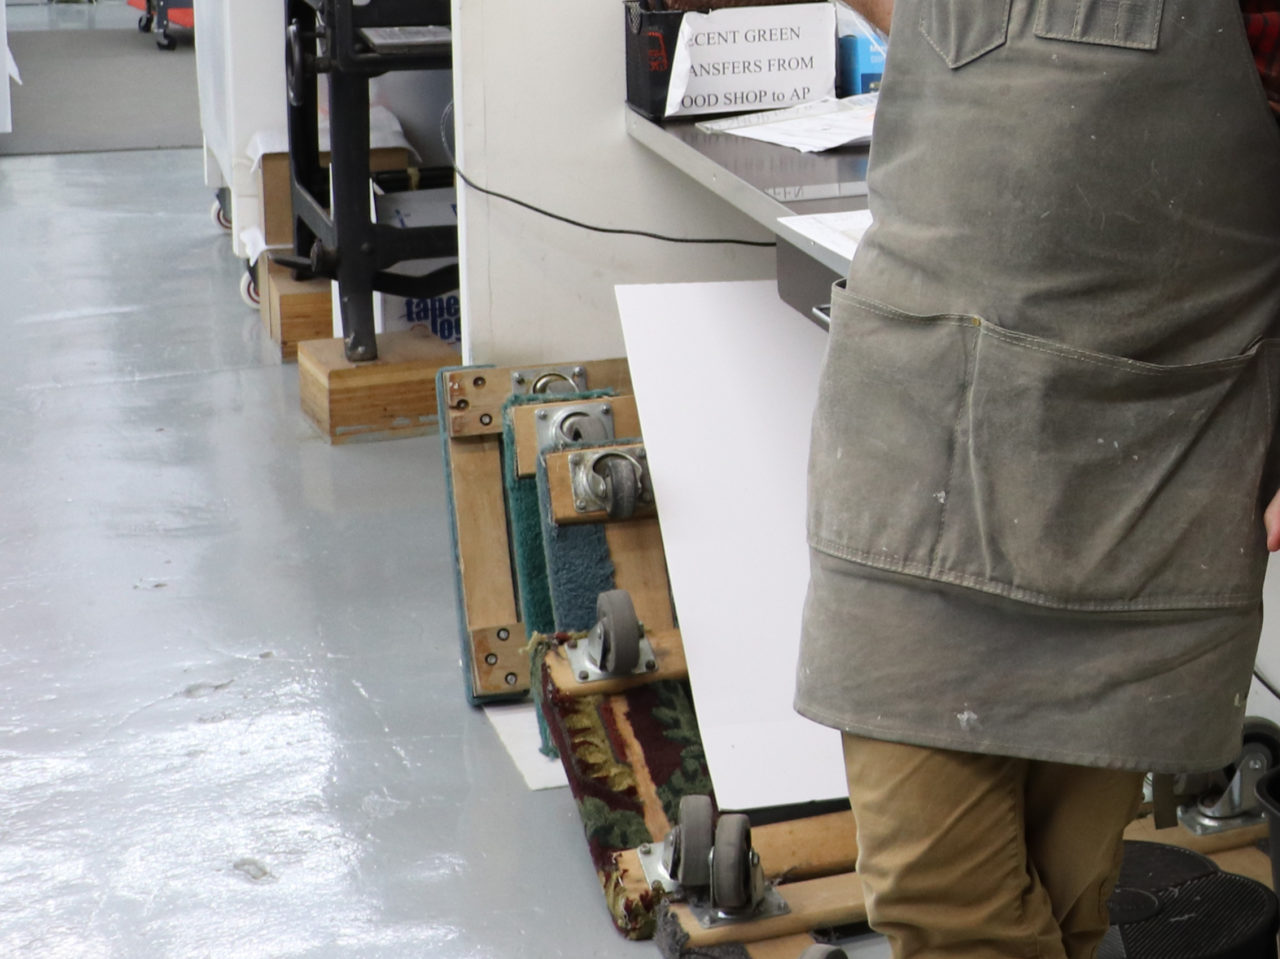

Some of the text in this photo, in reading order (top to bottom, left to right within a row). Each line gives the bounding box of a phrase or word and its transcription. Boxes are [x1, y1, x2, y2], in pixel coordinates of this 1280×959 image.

[744, 26, 801, 43] GREEN
[768, 56, 814, 72] FROM
[723, 90, 767, 105] SHOP
[772, 91, 785, 102] to
[790, 86, 811, 101] AP
